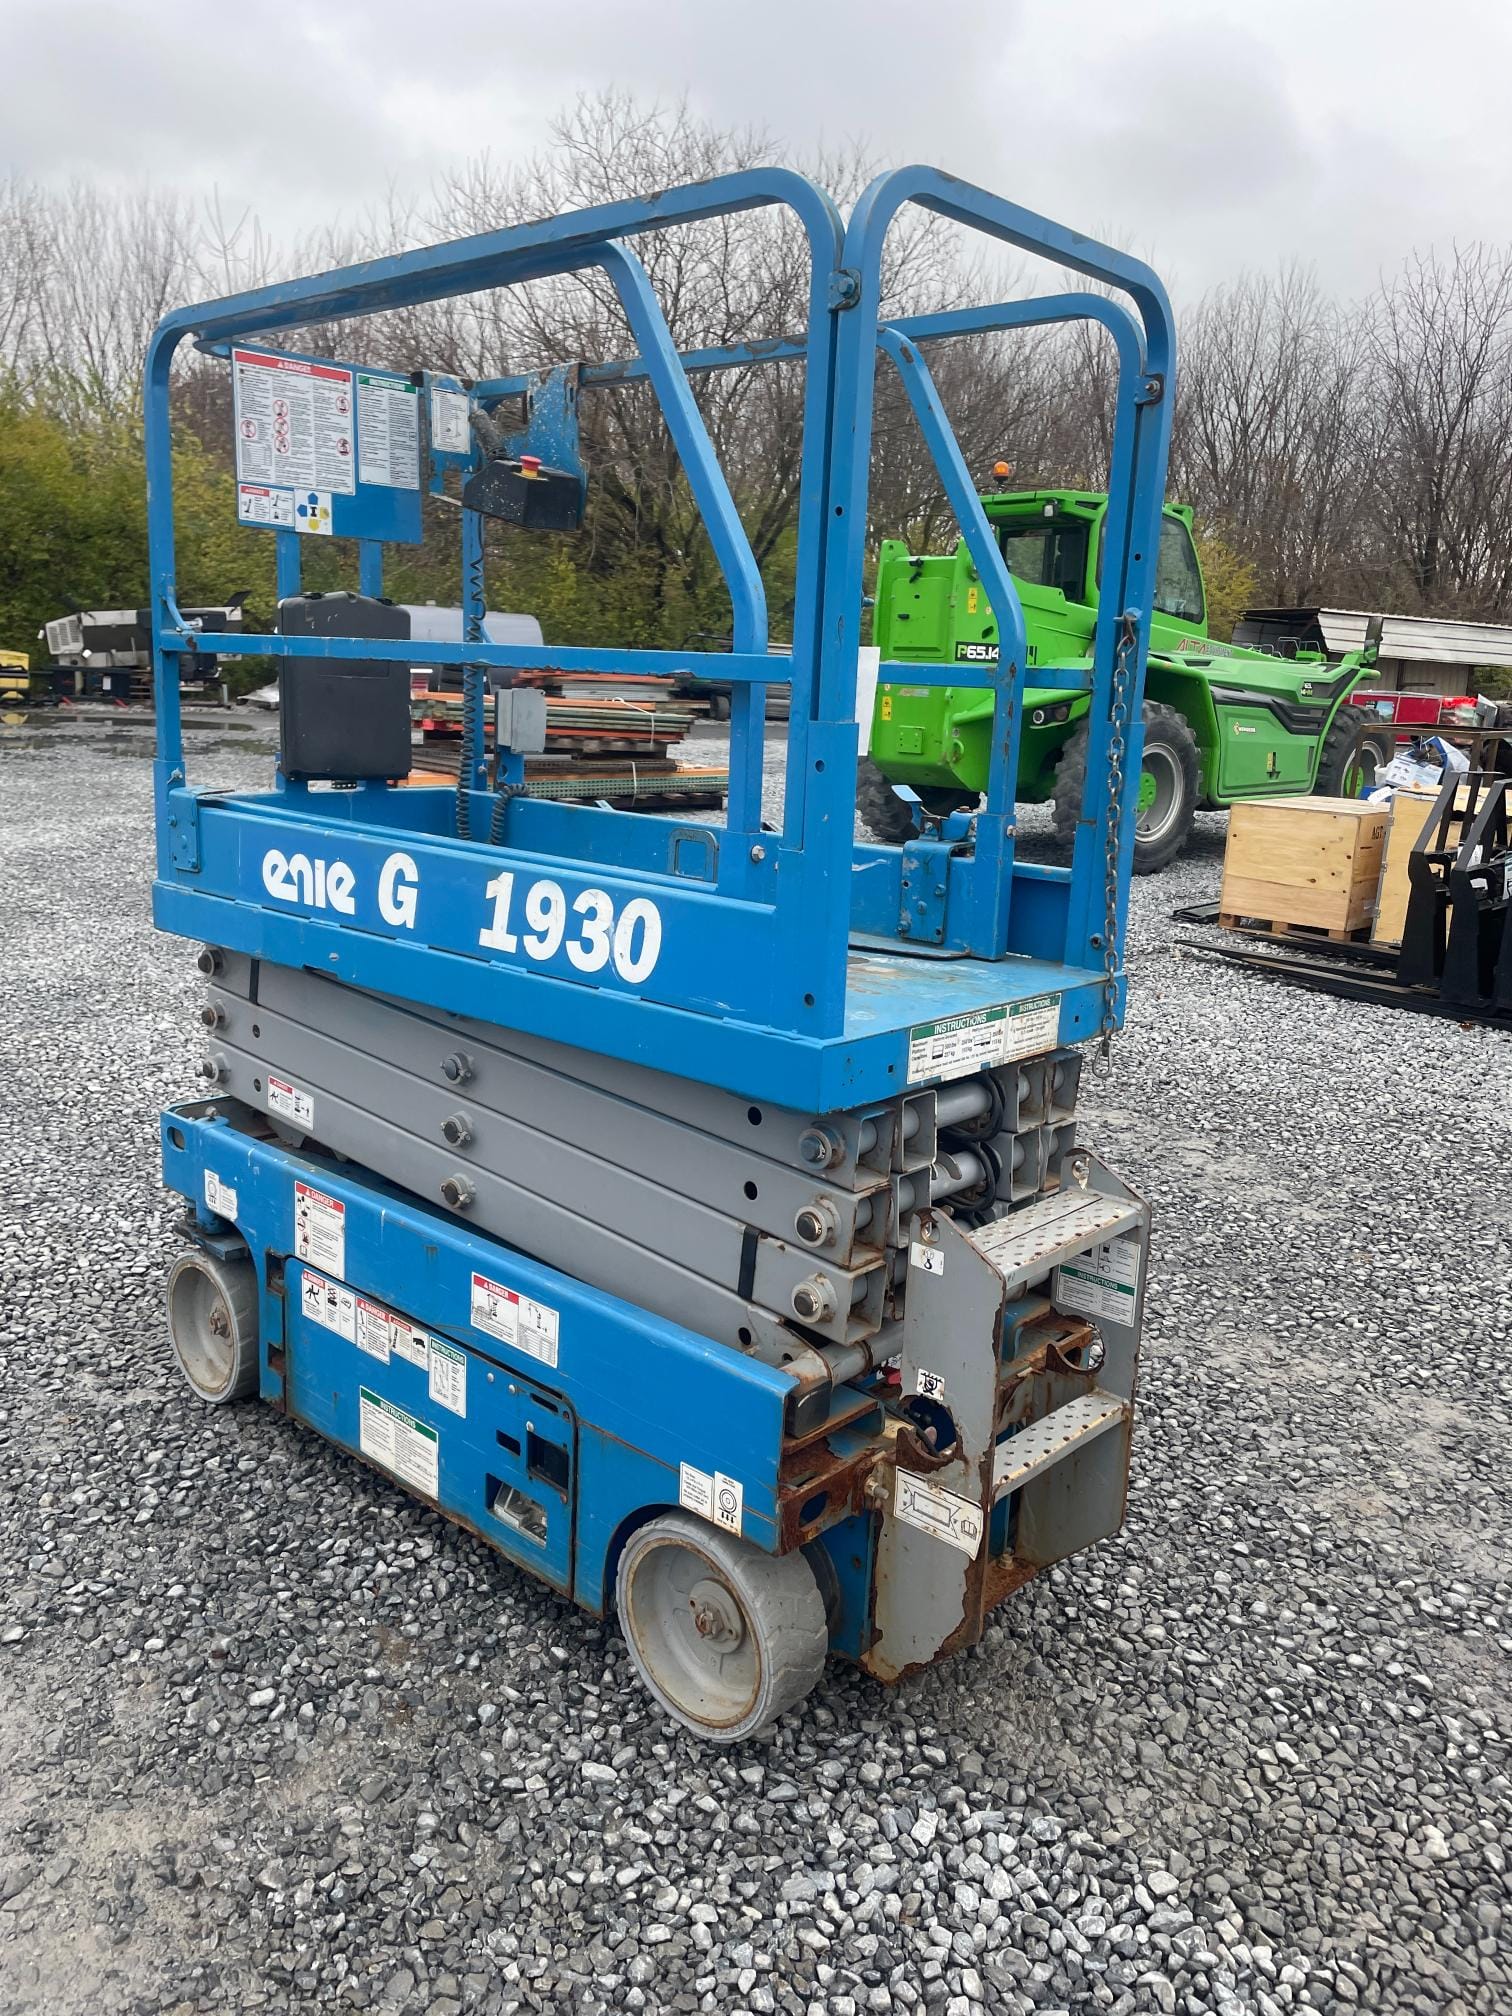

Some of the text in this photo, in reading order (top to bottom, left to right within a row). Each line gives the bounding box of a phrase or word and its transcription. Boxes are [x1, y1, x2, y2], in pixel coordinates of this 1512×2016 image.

[378, 852, 419, 929] G
[478, 871, 662, 984] 1930
[934, 1013, 987, 1035] INSTRUCTIONS
[311, 1190, 334, 1208] DANGER
[1077, 1271, 1118, 1290] INSTRUCTIONS
[380, 1401, 417, 1429] INSTRUCTIONS
